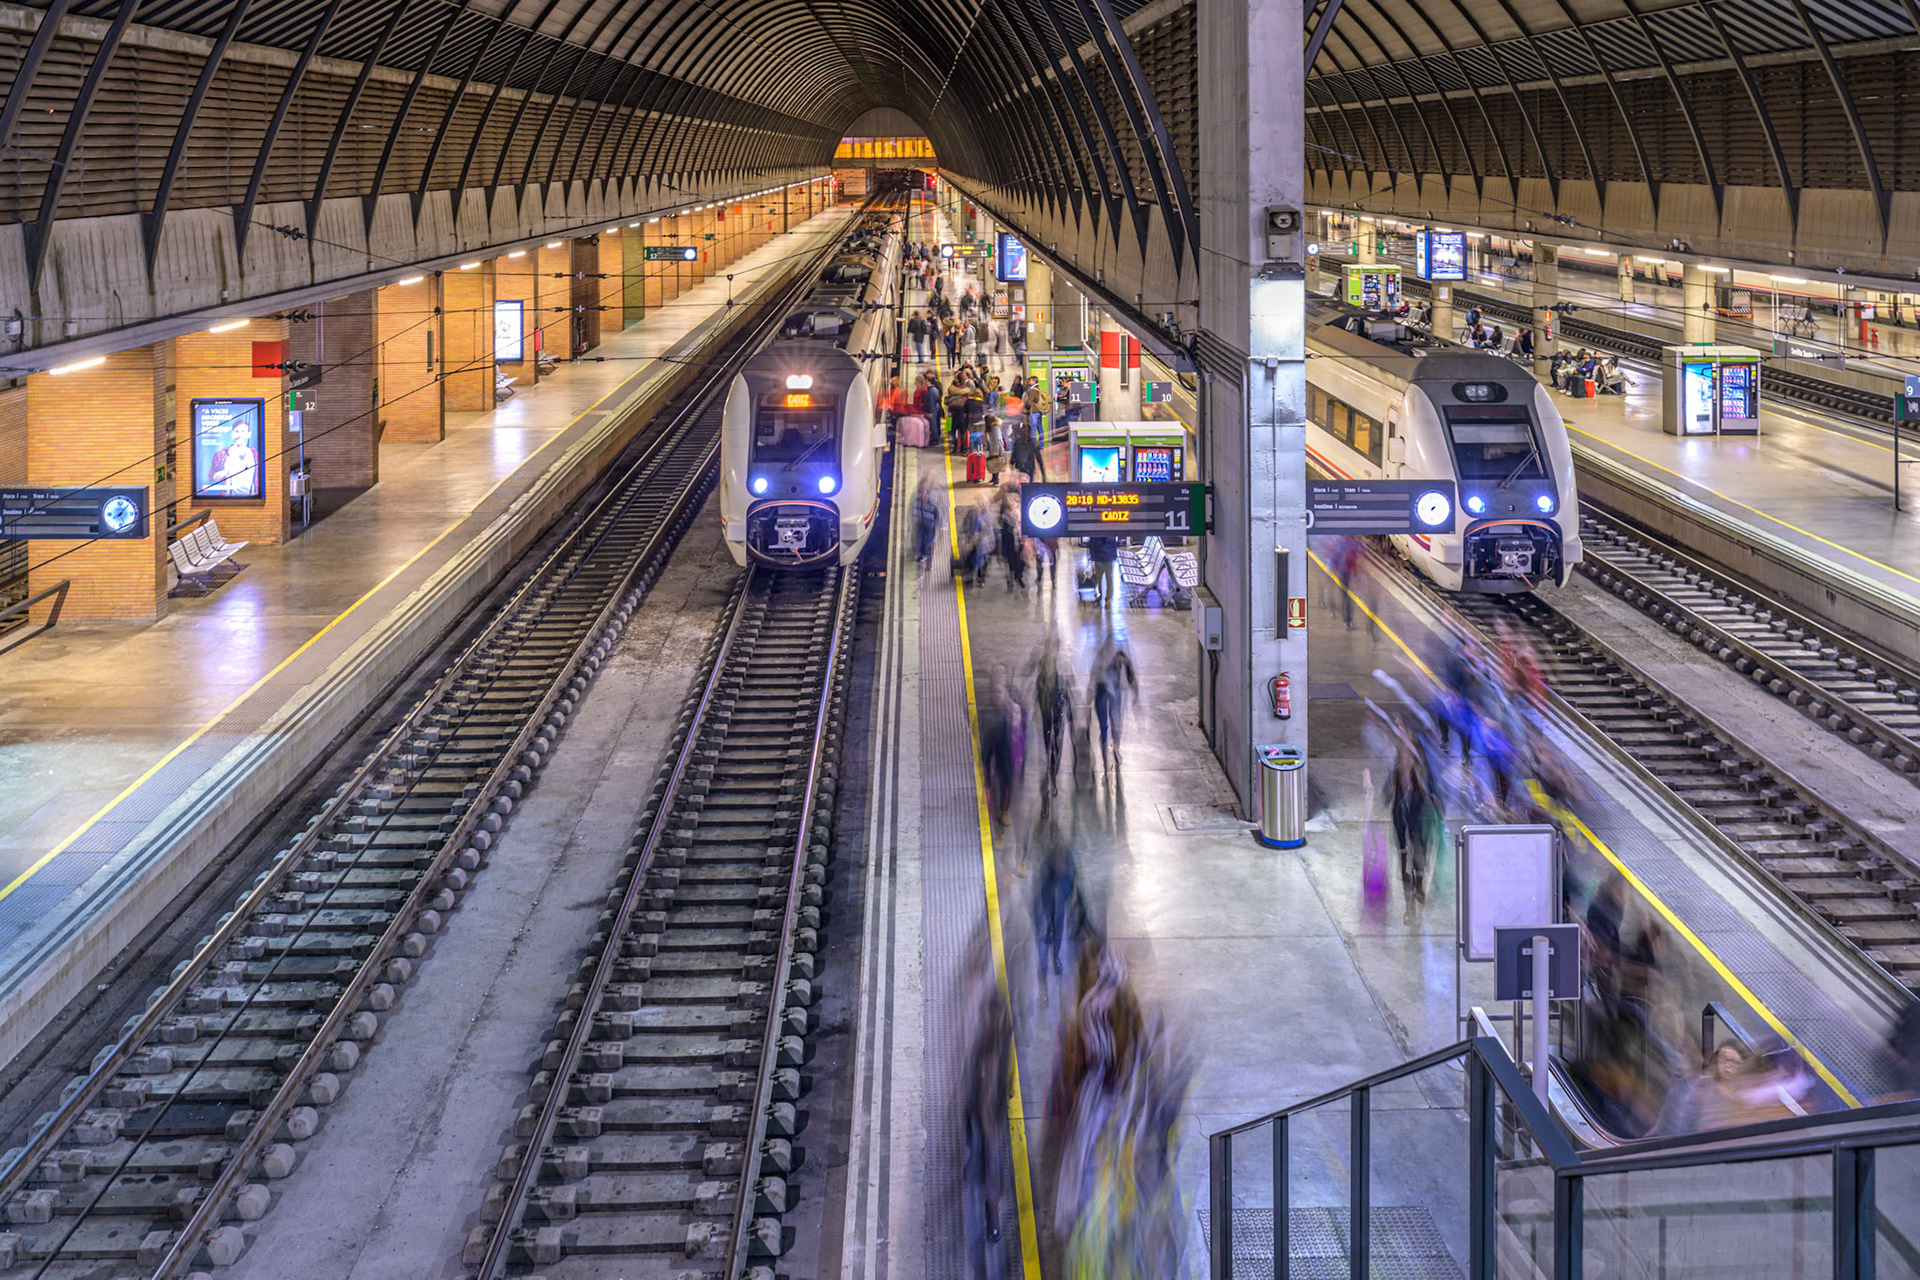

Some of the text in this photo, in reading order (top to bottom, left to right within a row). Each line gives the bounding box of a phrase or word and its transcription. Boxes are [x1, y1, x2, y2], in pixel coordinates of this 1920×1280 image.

[1906, 385, 1914, 396] 9
[1071, 393, 1081, 402] 11
[1161, 393, 1172, 402] 10
[305, 401, 316, 411] 12
[1101, 511, 1129, 521] CADIZ
[1165, 511, 1190, 530] 11
